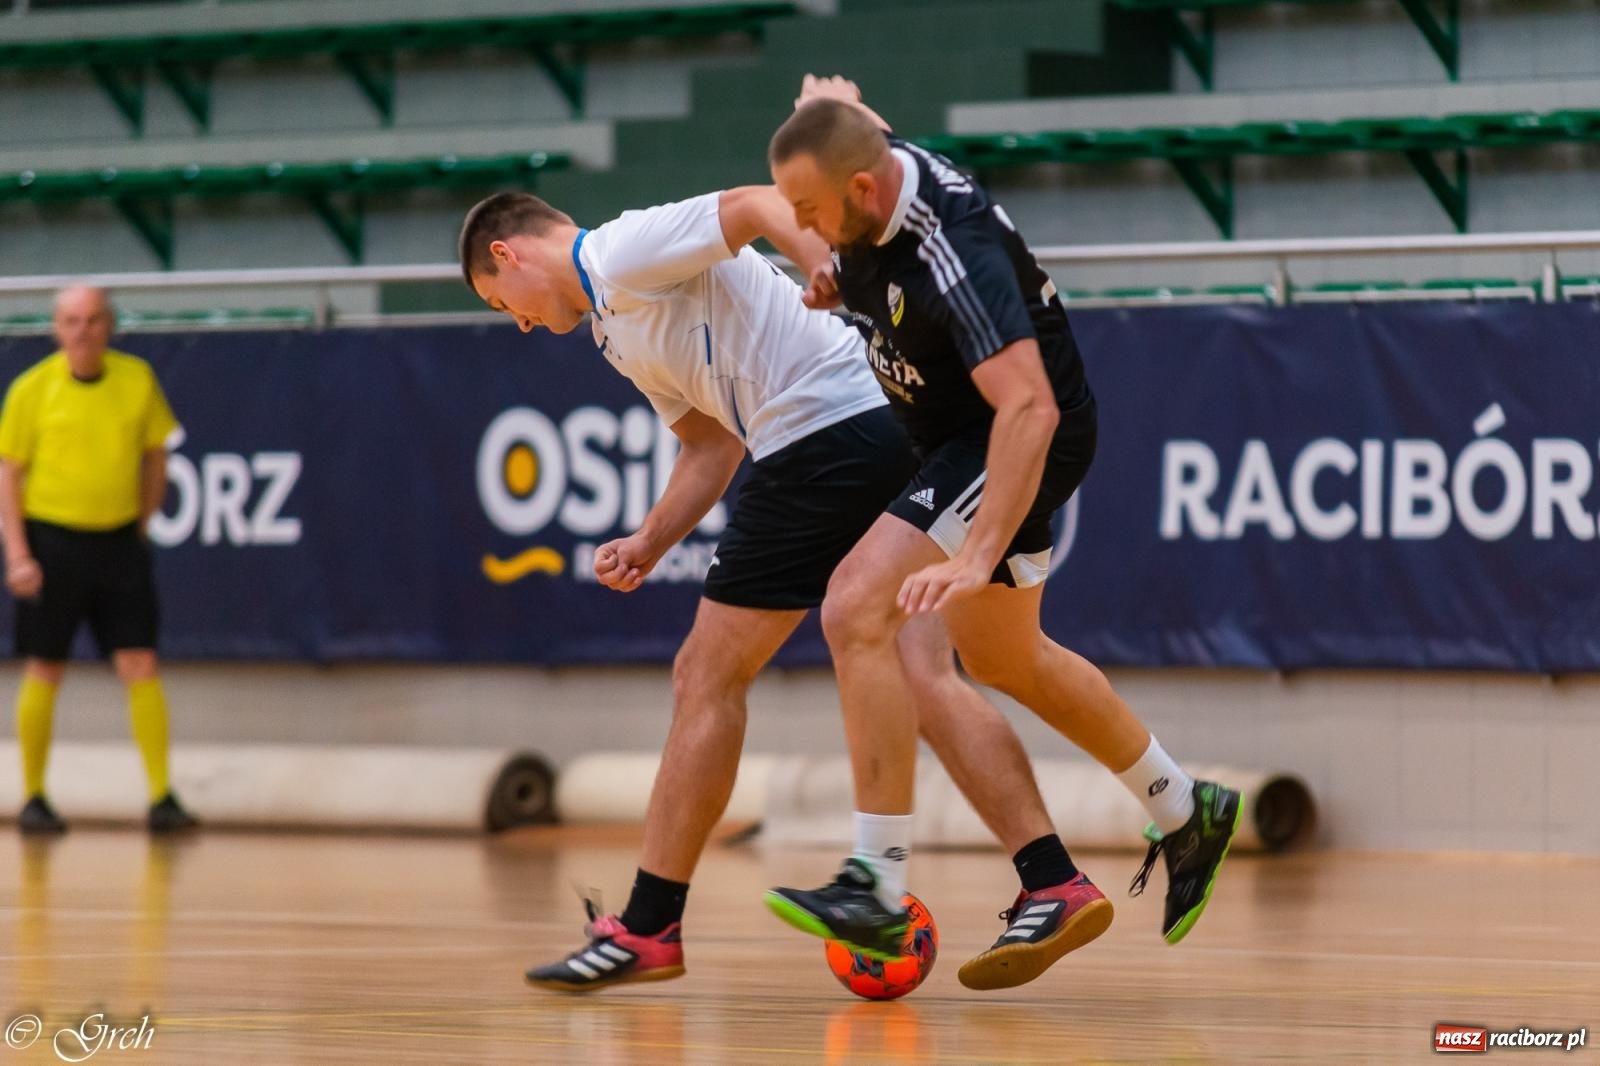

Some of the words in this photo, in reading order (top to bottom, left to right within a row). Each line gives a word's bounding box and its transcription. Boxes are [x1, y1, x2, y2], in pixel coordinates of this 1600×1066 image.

[146, 424, 303, 547] ÓRZ
[909, 494, 935, 511] adidas
[1159, 402, 1600, 542] RACIBÓR
